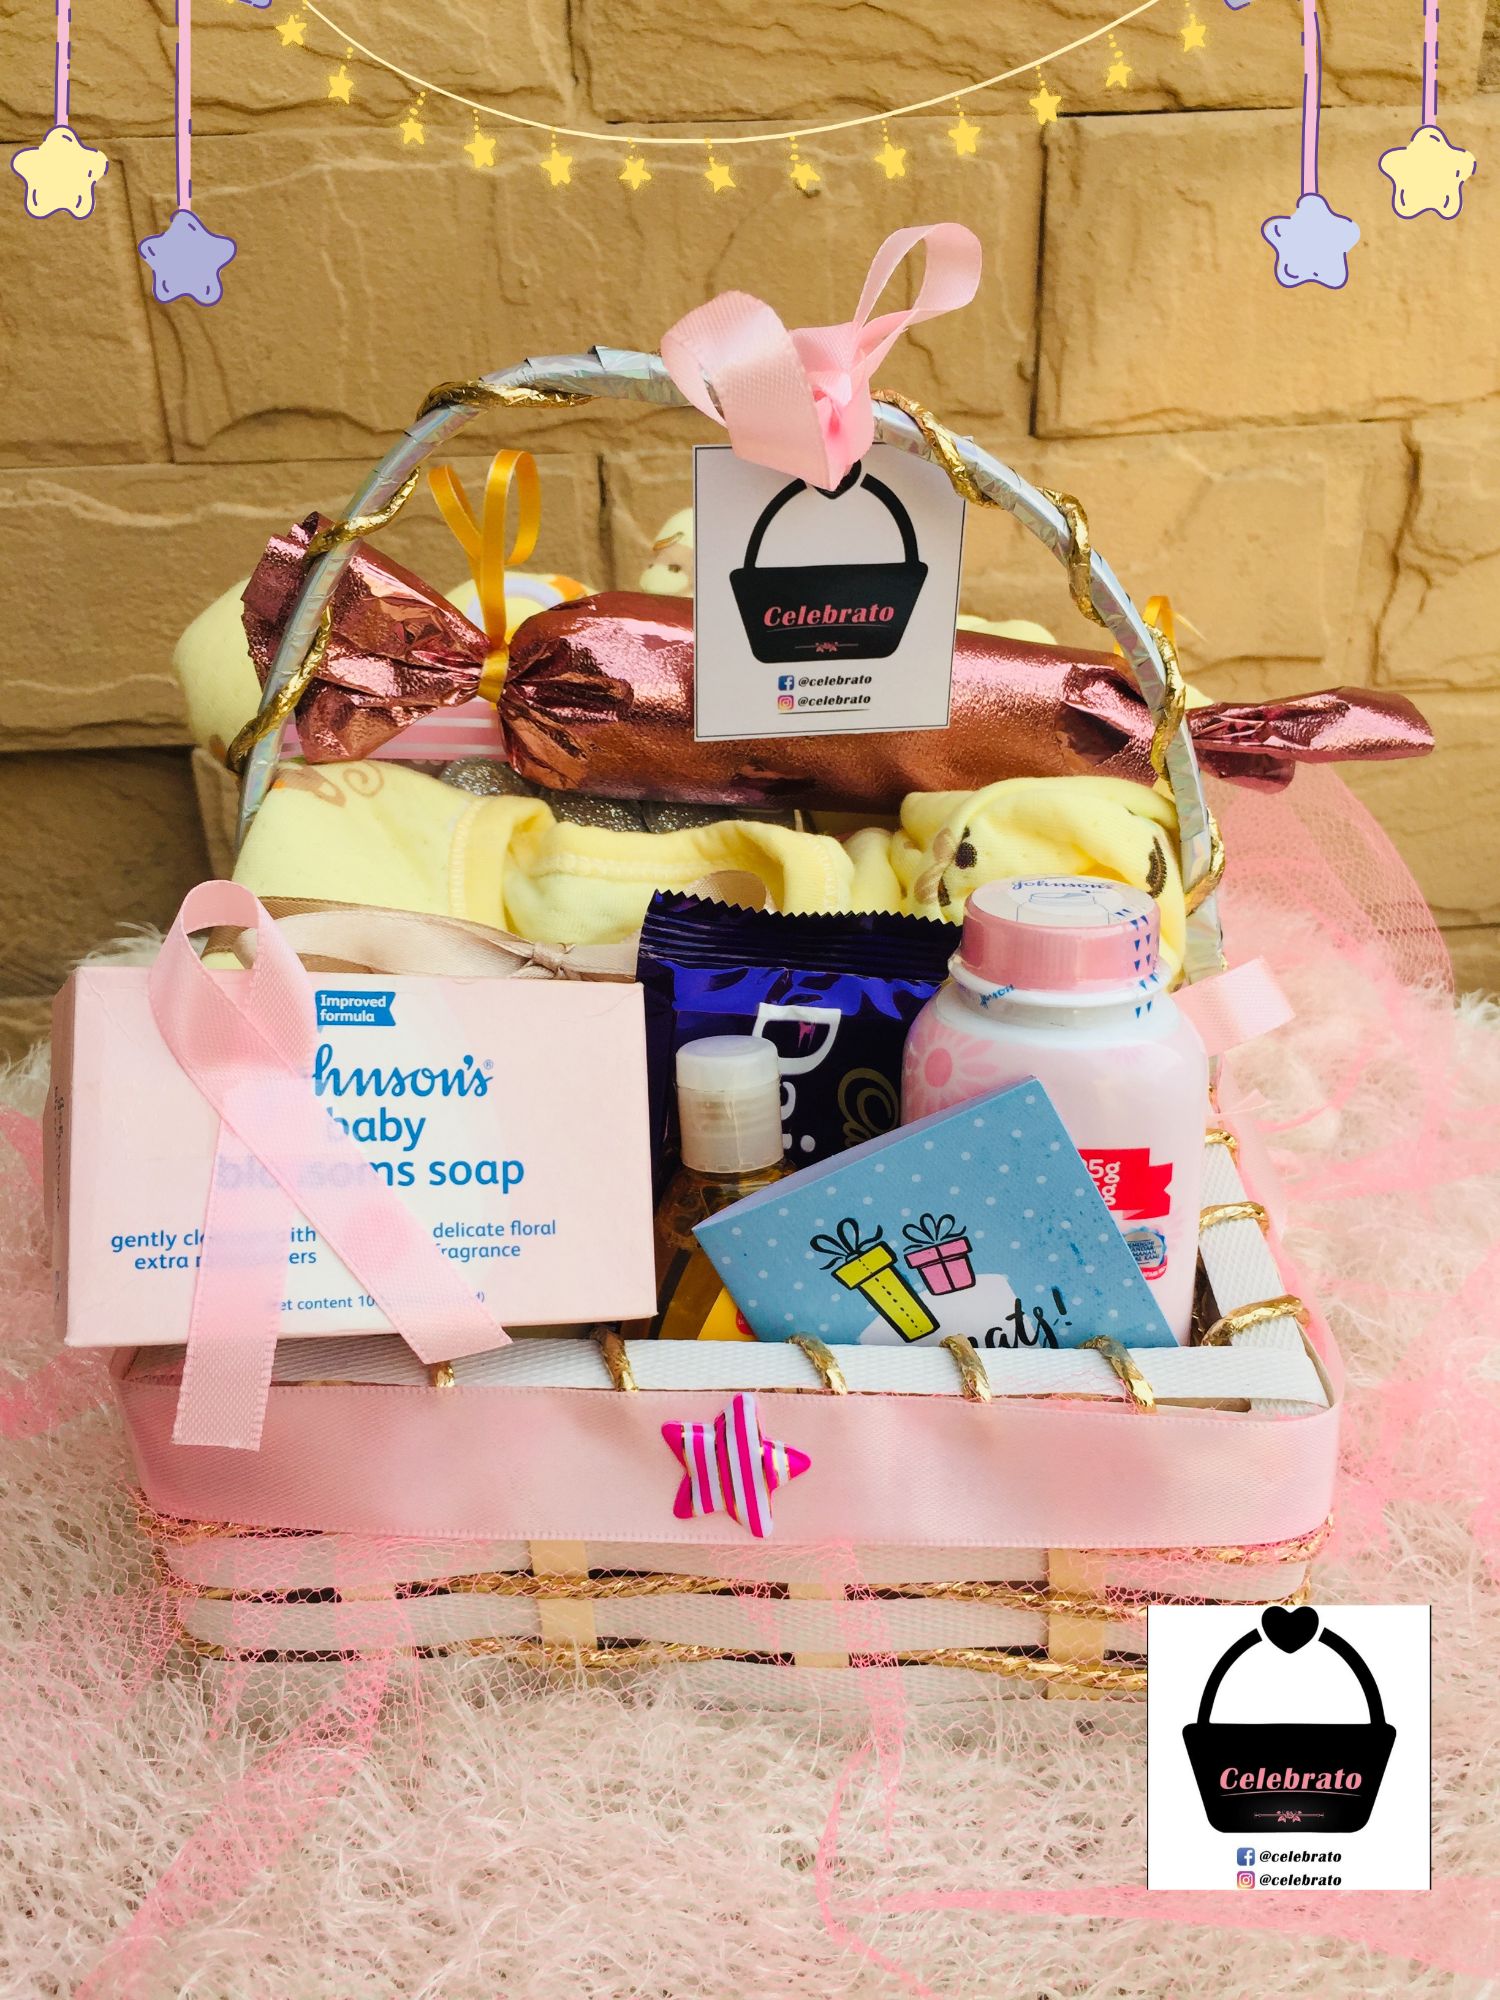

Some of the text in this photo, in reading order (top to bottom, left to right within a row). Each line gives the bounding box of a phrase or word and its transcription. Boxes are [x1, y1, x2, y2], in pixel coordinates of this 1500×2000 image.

[763, 604, 895, 627] Celebrato
[798, 675, 872, 688] @celebrato
[797, 694, 871, 707] @celebrato
[320, 994, 387, 1010] Improved
[320, 1009, 375, 1023] formula
[312, 1043, 493, 1097] hnson's
[429, 1159, 524, 1194] soap
[1083, 1159, 1121, 1184] 5g
[111, 1230, 177, 1252] gently
[290, 1226, 317, 1242] ith
[433, 1222, 505, 1238] delicate
[510, 1219, 556, 1236] floral
[134, 1256, 189, 1269] extra
[436, 1243, 521, 1262] ragrance
[280, 1299, 293, 1311] et
[297, 1296, 353, 1310] content
